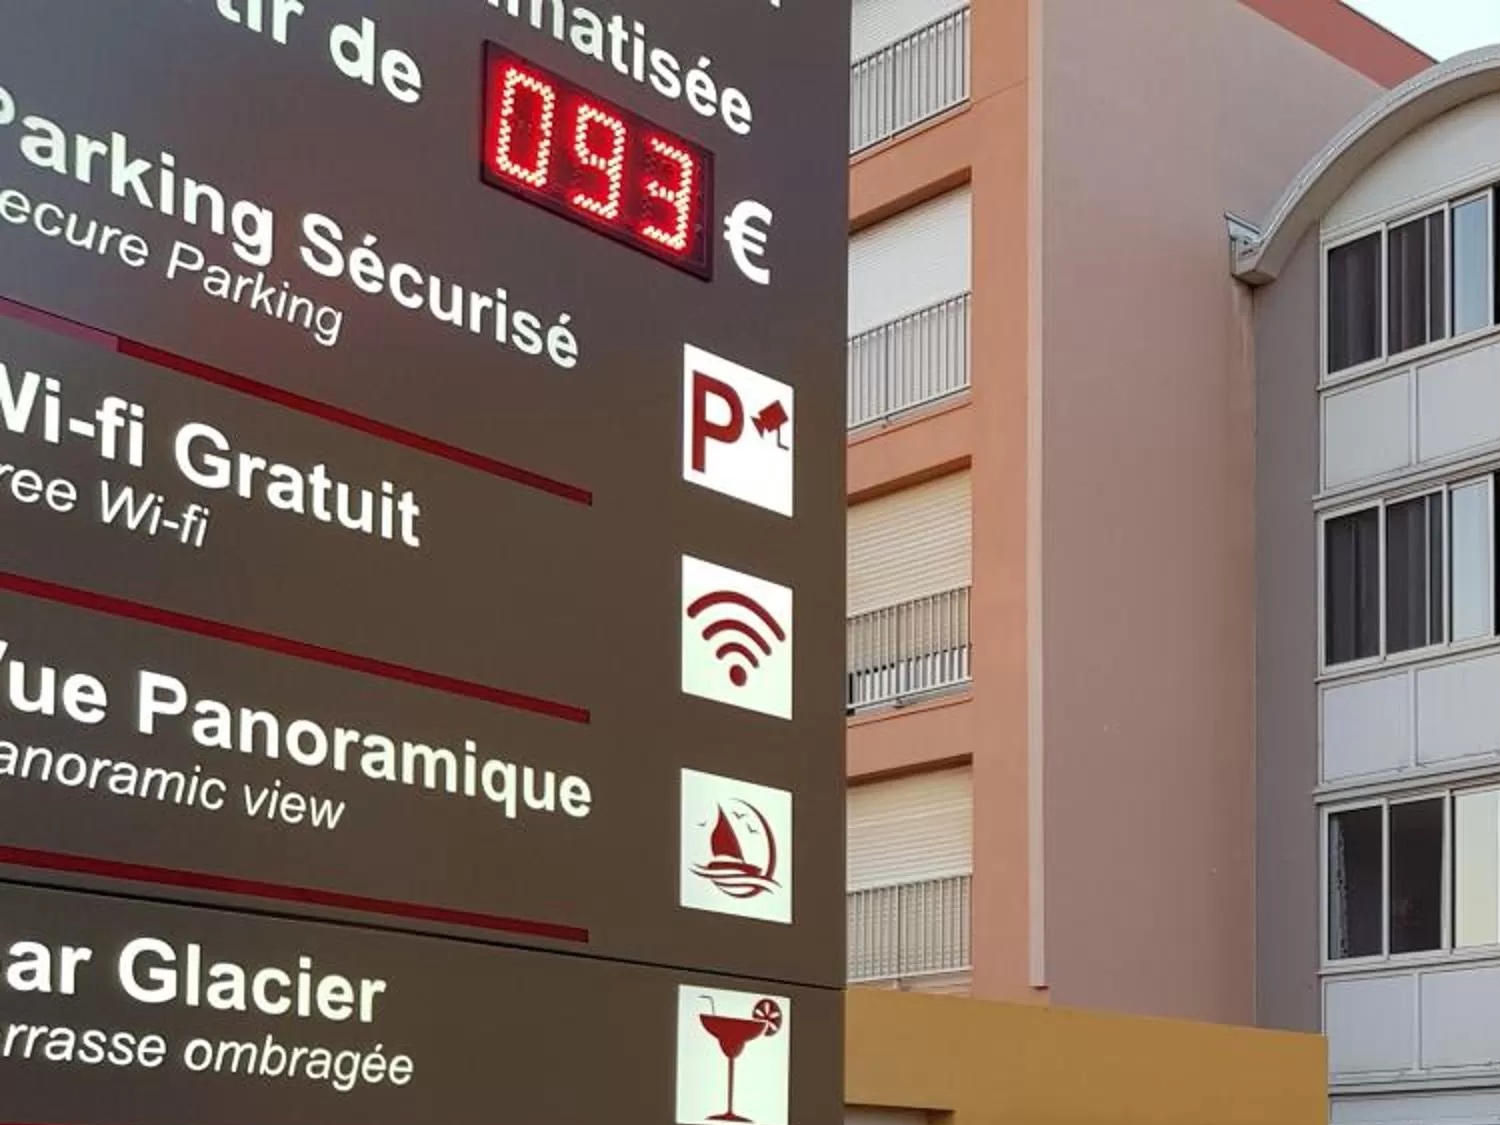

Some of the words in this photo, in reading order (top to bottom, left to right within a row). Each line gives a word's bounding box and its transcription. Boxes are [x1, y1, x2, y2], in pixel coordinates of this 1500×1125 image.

[329, 16, 422, 103] de
[487, 0, 753, 135] matisée
[496, 66, 694, 251] 093
[300, 212, 579, 369] Sécurisé
[723, 200, 773, 284] €
[165, 240, 343, 347] Parking
[100, 479, 210, 548] Wi-fi
[174, 422, 421, 548] Gratuit
[0, 640, 108, 724] ue
[138, 669, 592, 819] Panoramique
[243, 784, 346, 830] view
[117, 937, 387, 1023] Glacier
[183, 1034, 414, 1092] ombragée
